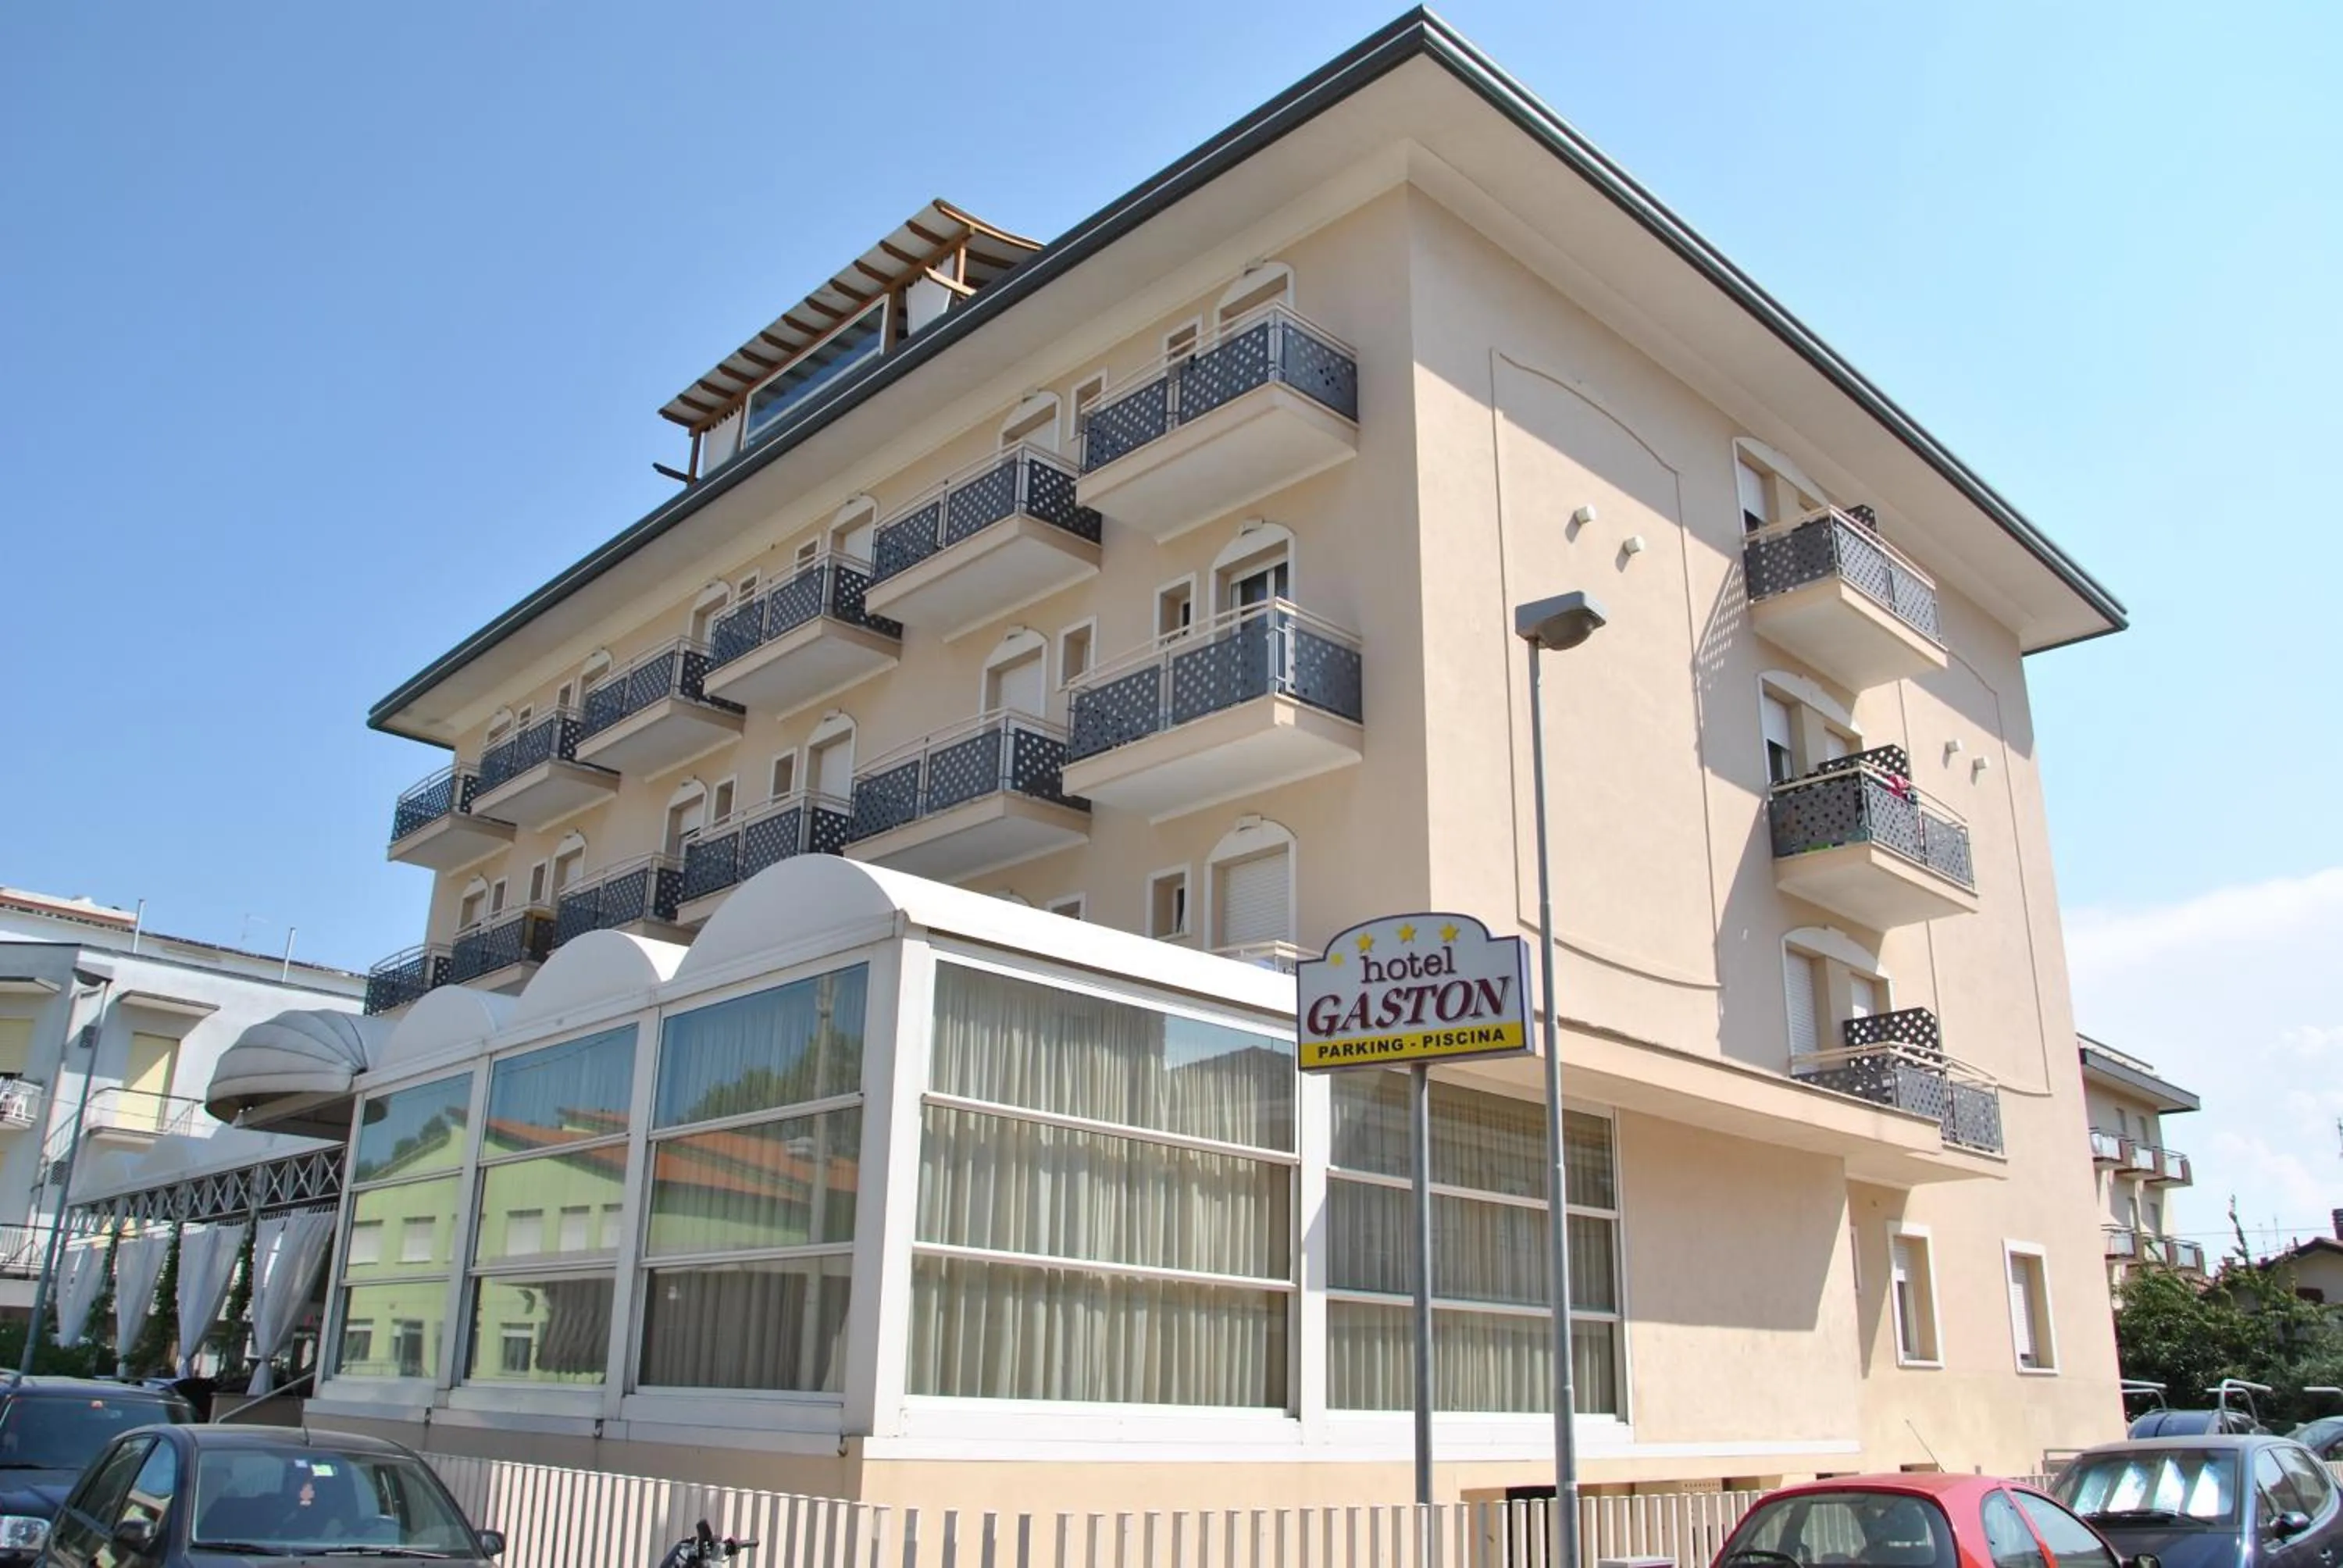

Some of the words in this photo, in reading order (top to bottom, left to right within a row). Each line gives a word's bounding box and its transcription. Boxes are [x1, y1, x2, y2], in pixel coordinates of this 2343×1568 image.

[1360, 946, 1458, 984] hotel
[1307, 975, 1512, 1037] GASTON
[1318, 1038, 1404, 1058] PARKING
[1423, 1028, 1505, 1049] PISCINA
